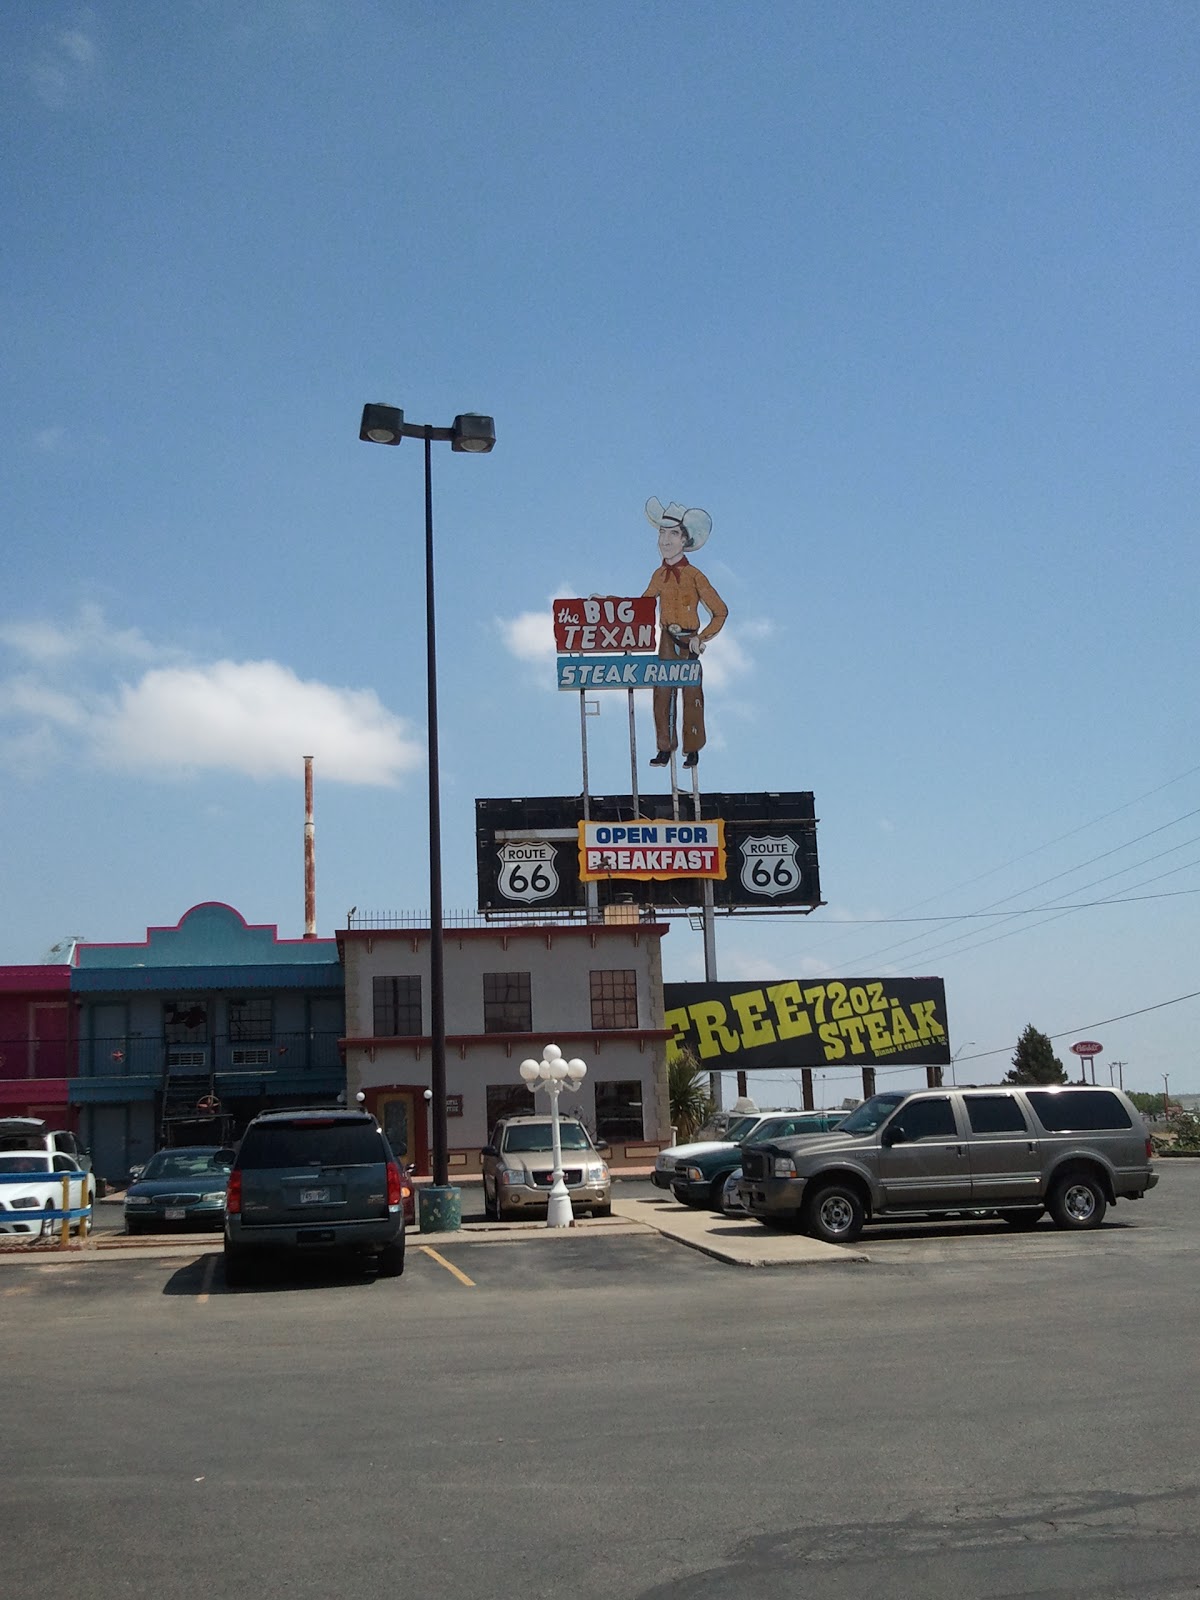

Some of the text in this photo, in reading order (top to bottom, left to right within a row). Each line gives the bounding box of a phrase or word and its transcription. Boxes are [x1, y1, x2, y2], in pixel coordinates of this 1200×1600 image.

[558, 600, 635, 624] the BIG
[564, 625, 652, 650] TEXAN
[560, 663, 700, 685] STEAK RANCH
[596, 827, 708, 844] OPEN FOR
[508, 849, 546, 859] ROUTE
[750, 843, 788, 853] ROUTE
[587, 850, 714, 870] BREAKFAST
[509, 864, 550, 893] 66
[752, 858, 792, 887] 66
[818, 1000, 945, 1061] STEAK
